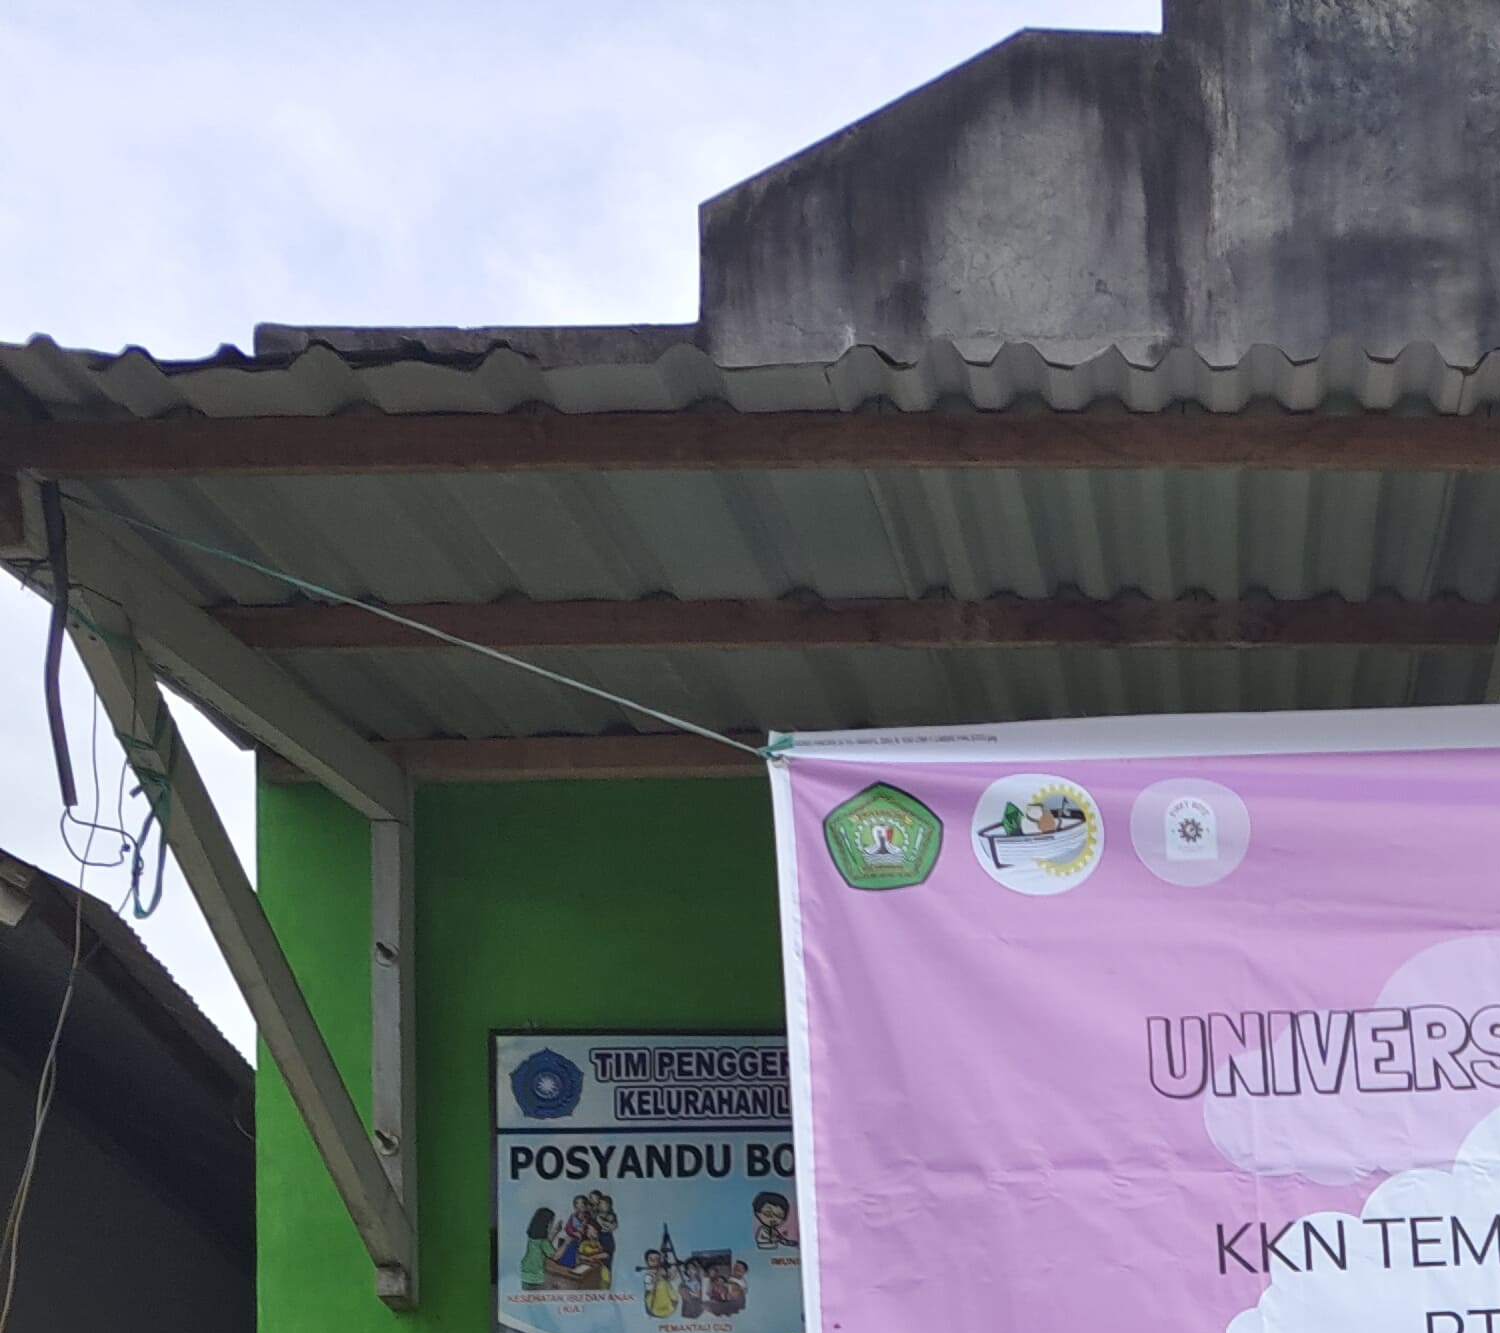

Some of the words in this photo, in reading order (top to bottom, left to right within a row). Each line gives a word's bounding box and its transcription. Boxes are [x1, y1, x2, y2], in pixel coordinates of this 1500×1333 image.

[593, 1050, 649, 1080] TIM
[618, 1087, 769, 1117] KELURAHAN
[509, 1143, 732, 1181] POSYANDU
[1215, 1219, 1350, 1275] KKN
